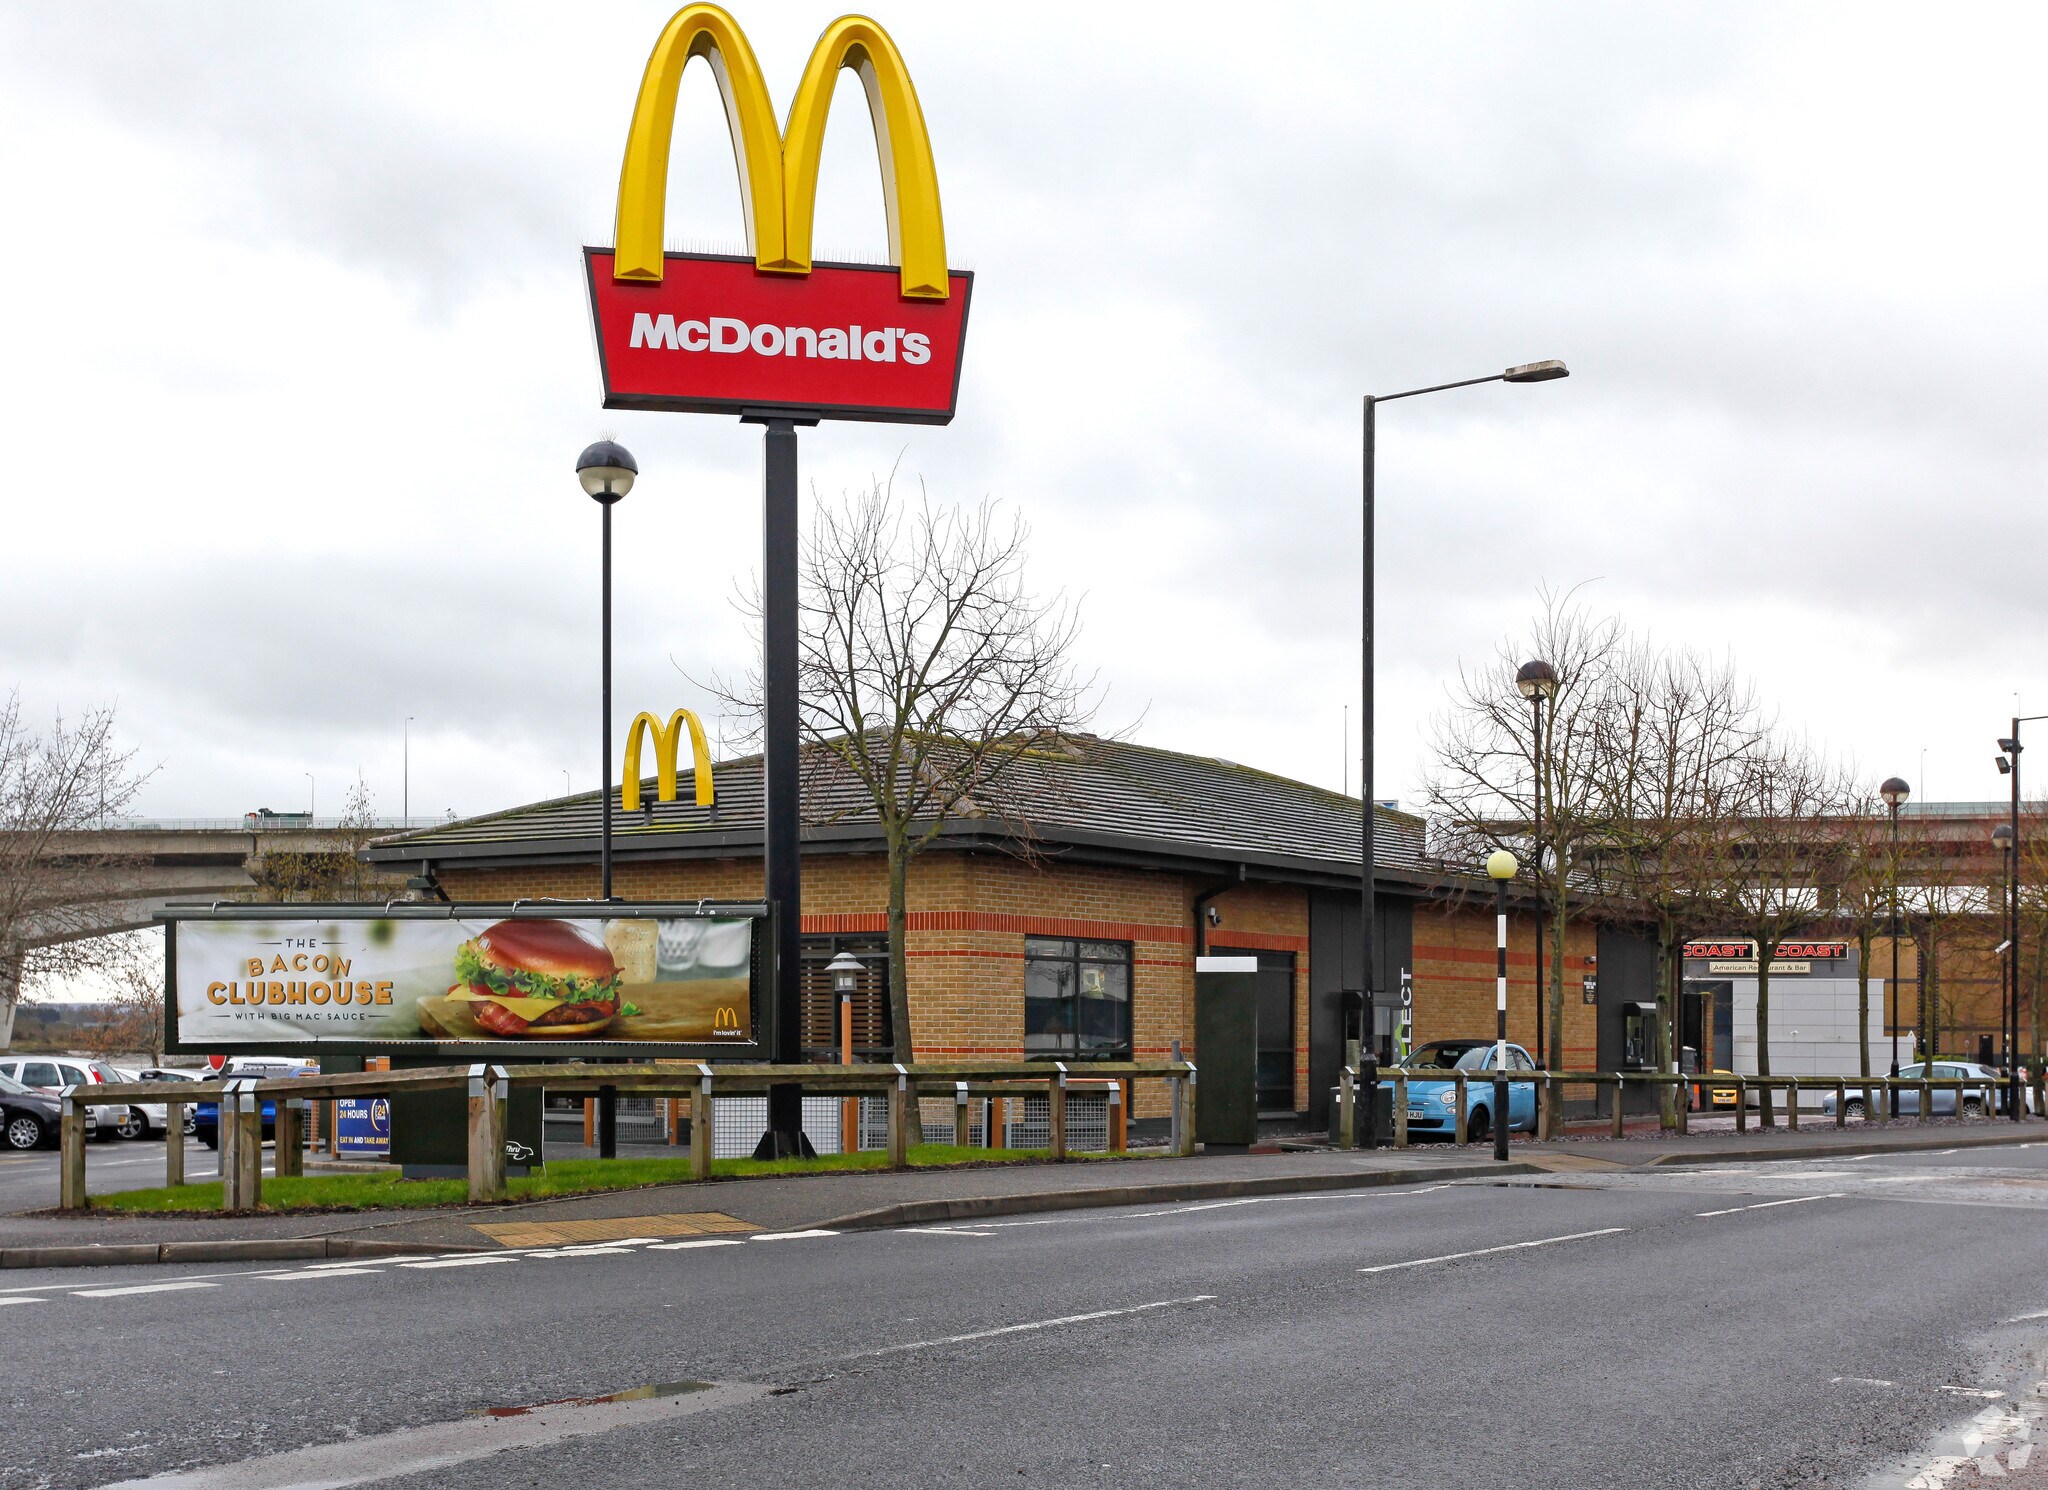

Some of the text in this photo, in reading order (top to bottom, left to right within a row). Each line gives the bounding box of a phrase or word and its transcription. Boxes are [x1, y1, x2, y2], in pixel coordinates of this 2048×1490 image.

[629, 312, 932, 365] McDonald's
[286, 939, 317, 948] THE
[1683, 944, 1748, 957] COAST
[1774, 944, 1843, 957] COAST
[247, 953, 352, 977] BACON
[207, 981, 394, 1006] CLUBHOUSE
[235, 1013, 265, 1021] WITH
[271, 1013, 291, 1021] BIG
[327, 1013, 366, 1021] SAUCE
[340, 1099, 355, 1107] OPEN
[340, 1109, 346, 1119] 24
[347, 1109, 368, 1119] HOURS
[377, 1105, 386, 1116] 24
